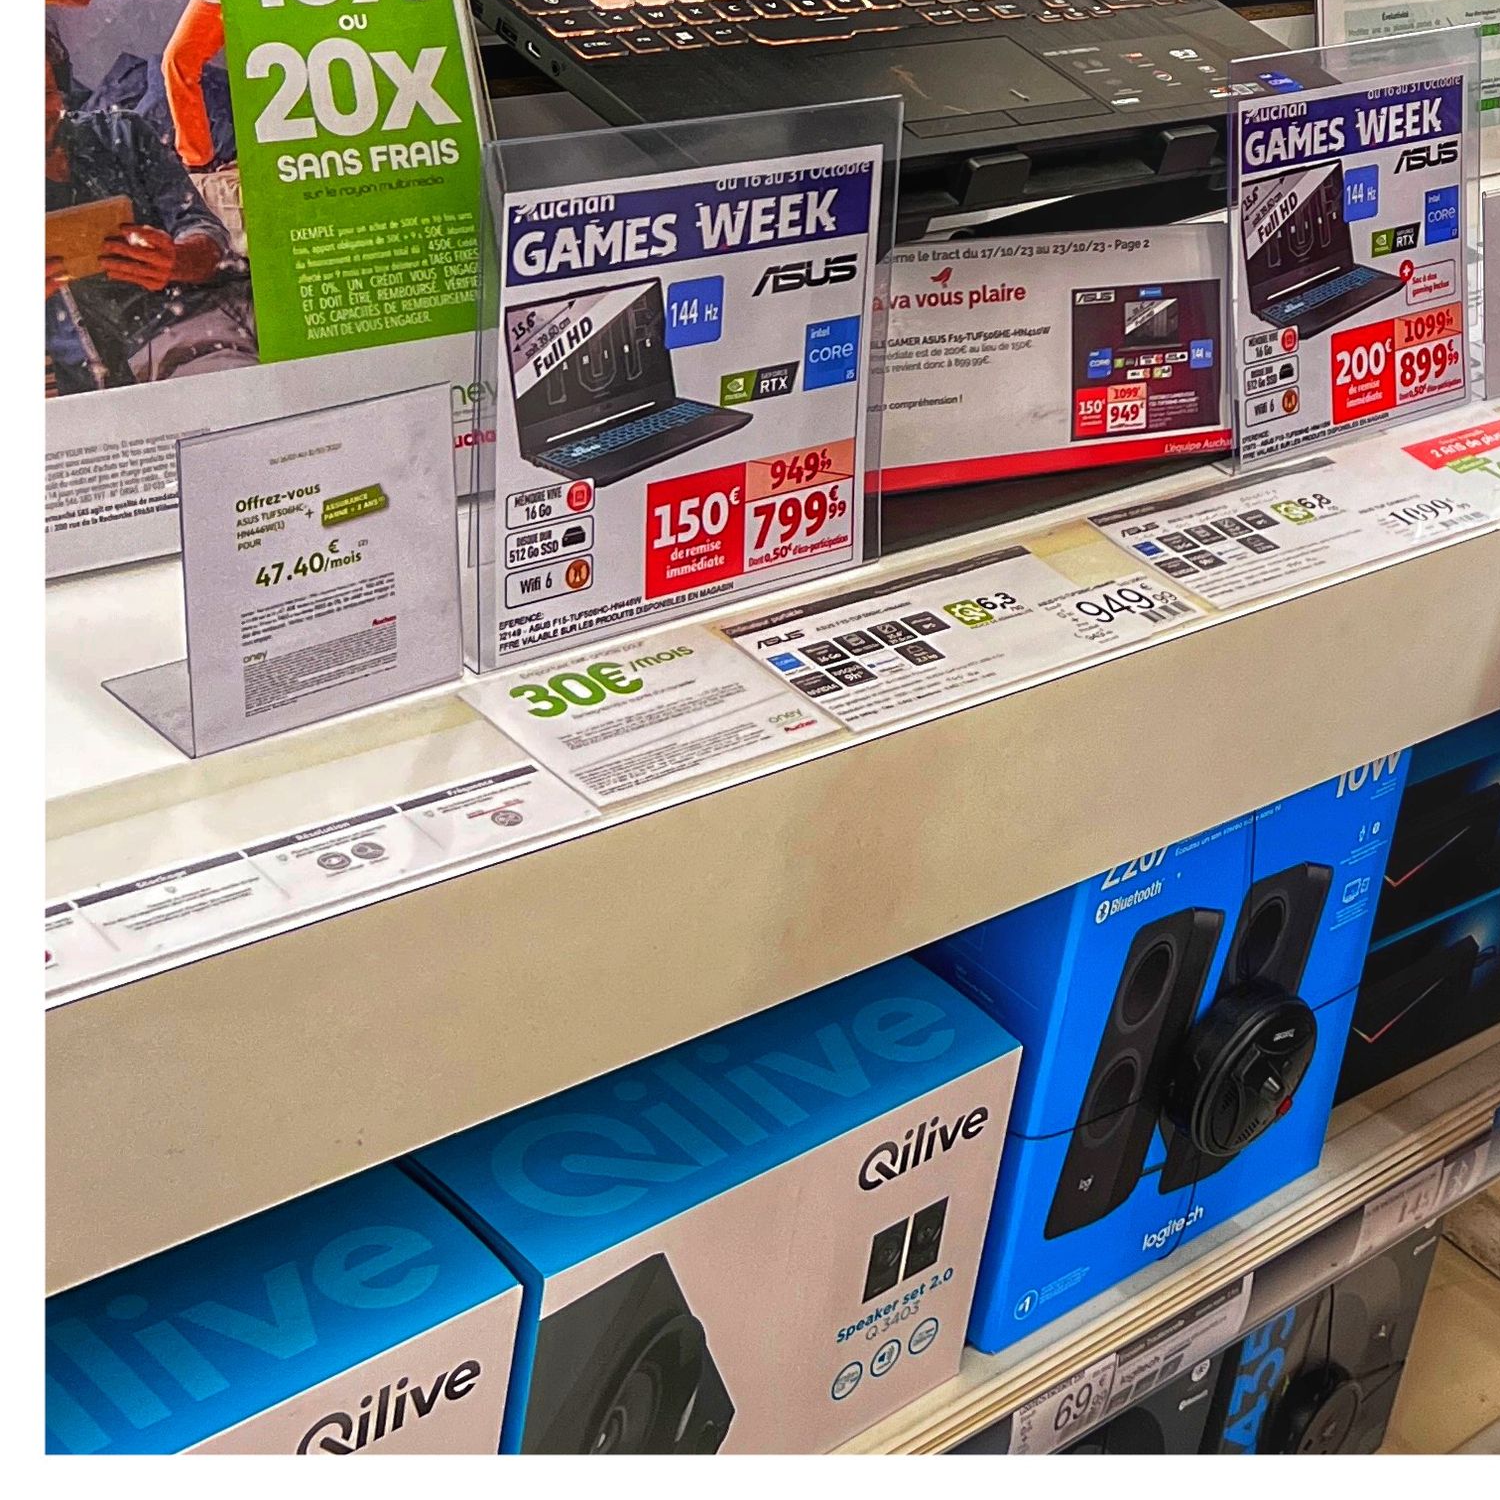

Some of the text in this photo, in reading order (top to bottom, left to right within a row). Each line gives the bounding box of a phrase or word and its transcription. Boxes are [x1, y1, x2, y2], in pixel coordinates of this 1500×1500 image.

[1244, 102, 1307, 125] Auchan
[1245, 97, 1442, 167] GAMES WEEK
[277, 138, 460, 182] SANS FRAIS
[1393, 141, 1459, 174] ASUS
[810, 161, 871, 181] Octobre
[1346, 183, 1377, 205] 144 Hz
[513, 194, 615, 225] Auchan
[290, 226, 335, 241] EXEMPLE
[512, 188, 839, 277] GAMES WEEK
[1396, 232, 1415, 248] RTX
[932, 238, 1150, 261] tract du 17/10/23 au 23/10/23 Page 2
[410, 268, 437, 281] VOUS
[752, 253, 858, 297] ASUS
[890, 283, 1026, 310] va vous plaire
[670, 299, 719, 326] 144 Hz
[532, 315, 594, 379] Full HD
[887, 336, 921, 348] GAMER
[921, 333, 947, 345] ASUS
[924, 359, 946, 370] donc
[759, 374, 789, 395] RTX
[889, 396, 957, 413] compréhension
[1164, 440, 1201, 453] L'équipe
[235, 484, 321, 513] Offrez-vous
[525, 503, 552, 519] 16 Go
[509, 539, 559, 562] 512 Go SSD
[670, 538, 722, 561] de remise
[665, 553, 726, 580] immédiate
[520, 574, 553, 595] Wifi 6
[522, 629, 559, 647] VALABLE
[560, 623, 579, 638] SUR
[757, 630, 805, 649] ASUS
[509, 645, 694, 718] 30€ /mois
[1110, 881, 1163, 915] Bluetooth
[491, 992, 957, 1217] Qilive
[858, 1106, 988, 1190] Qilive
[1142, 1205, 1204, 1251] logitech
[836, 1267, 953, 1343] Speaker set 2.0
[297, 1359, 481, 1455] Qilive
